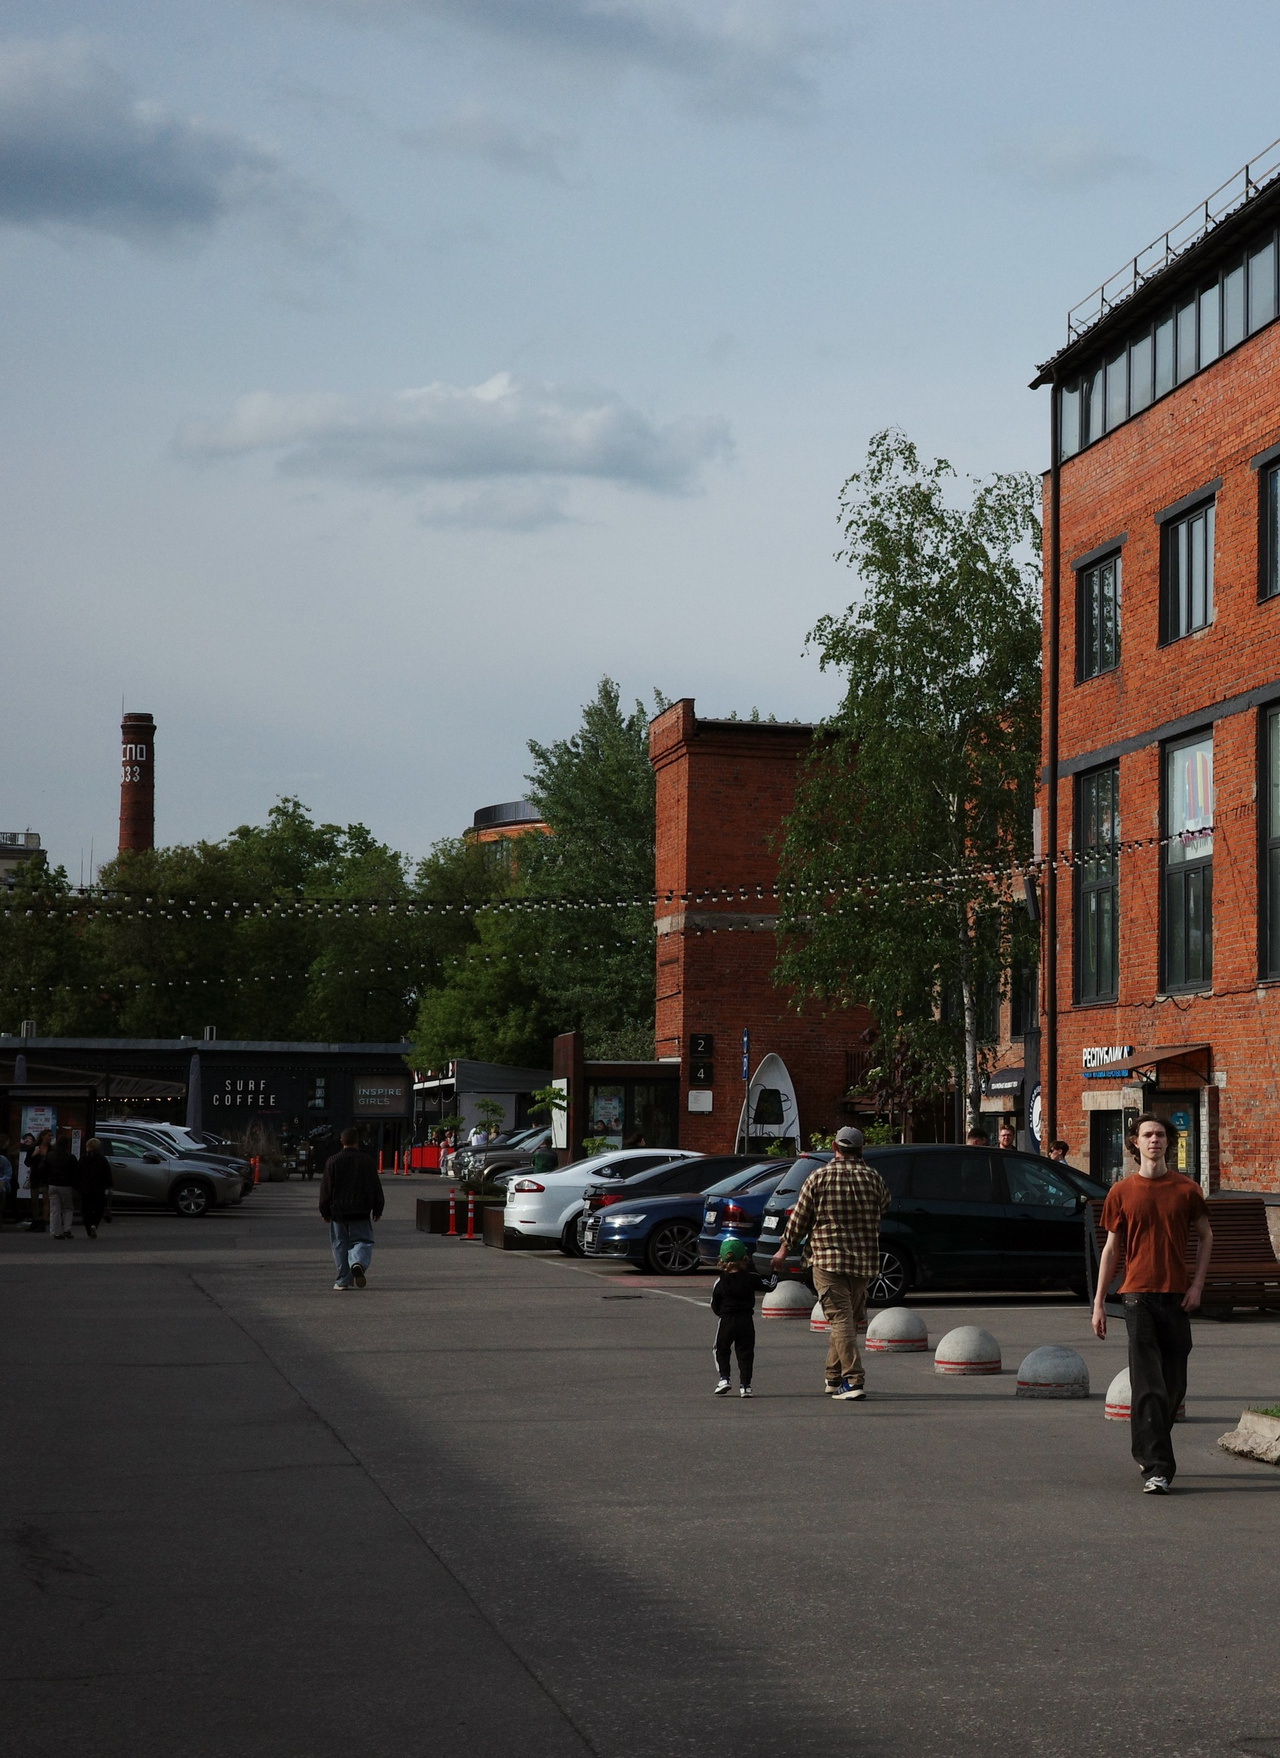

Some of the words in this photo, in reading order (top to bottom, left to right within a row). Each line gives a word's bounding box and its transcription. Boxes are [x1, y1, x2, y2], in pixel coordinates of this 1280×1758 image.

[697, 1040, 705, 1051] 2
[1082, 1045, 1129, 1068] РЕСПУБЛИКА
[697, 1068, 705, 1079] 4
[225, 1080, 267, 1091] SURF
[213, 1094, 276, 1106] COFFEE
